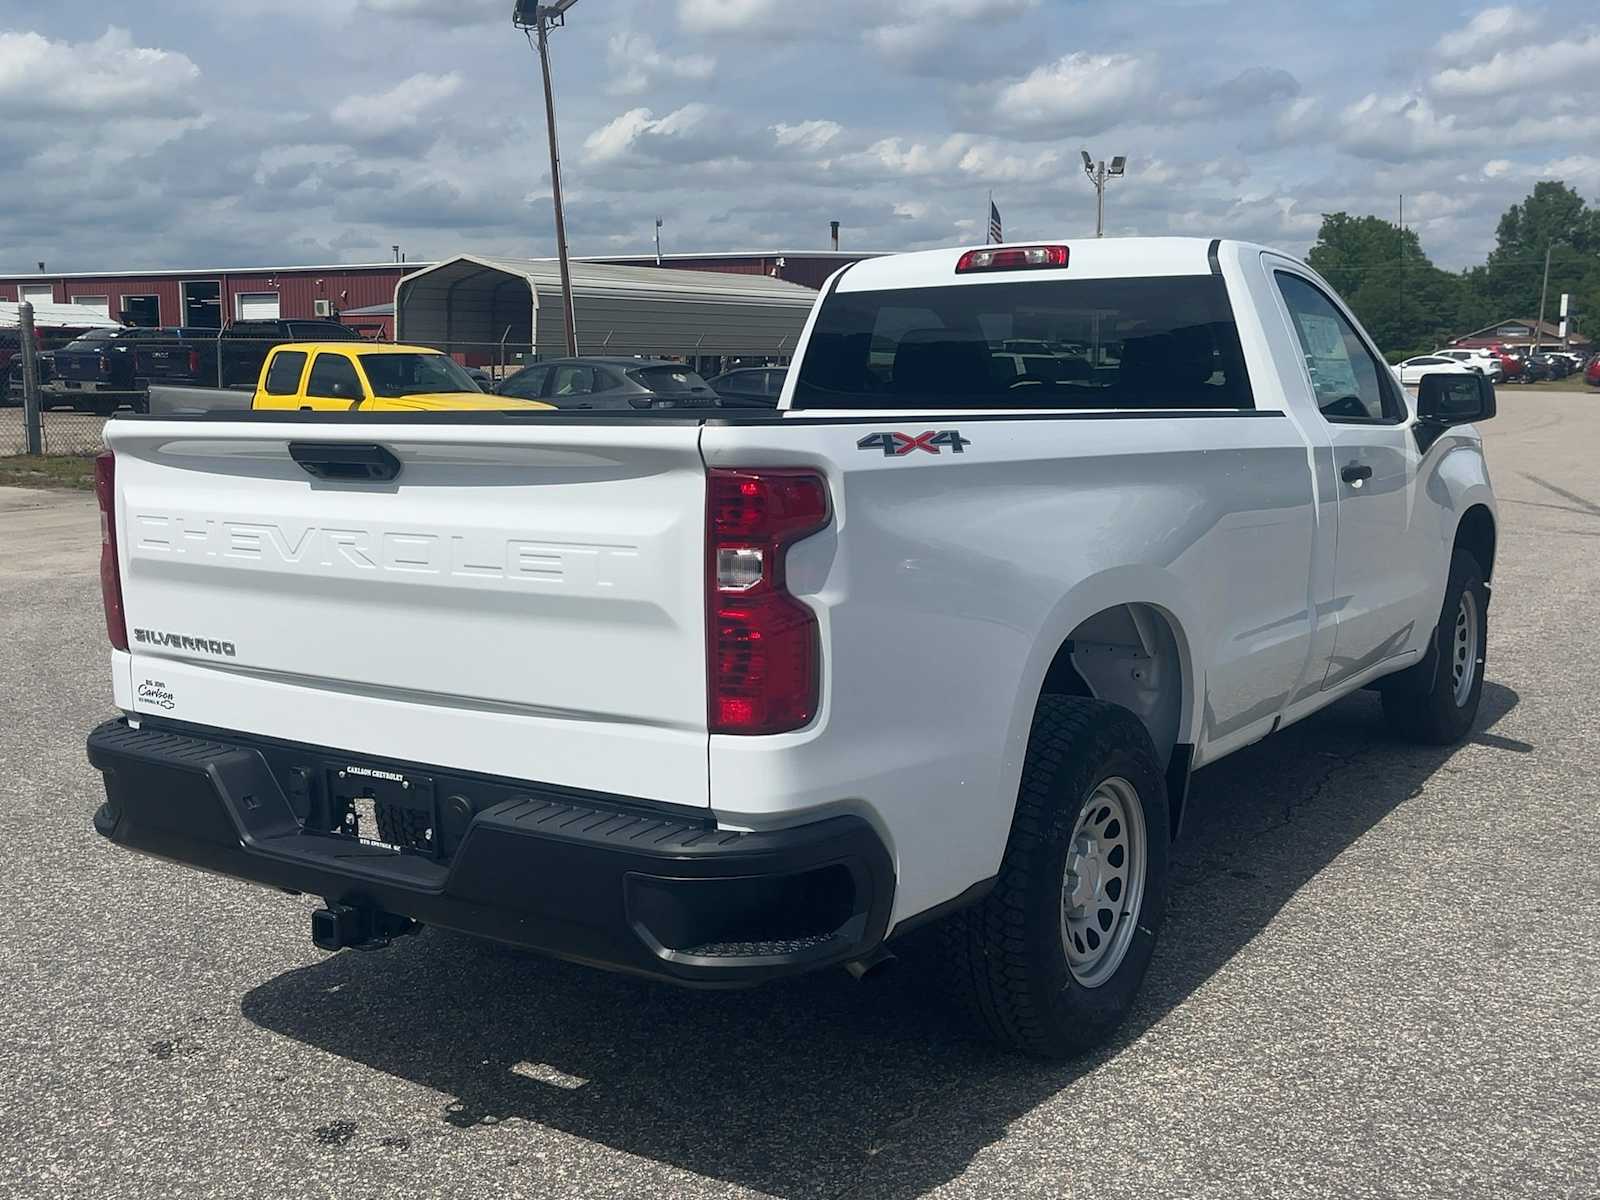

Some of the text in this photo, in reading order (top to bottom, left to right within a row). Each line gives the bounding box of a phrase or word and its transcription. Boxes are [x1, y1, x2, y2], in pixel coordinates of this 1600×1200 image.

[136, 513, 639, 586] CHEVROLET
[134, 628, 236, 656] SILVERADO
[138, 683, 173, 700] Carlson
[346, 766, 403, 781] CARLSON CHEVROLET
